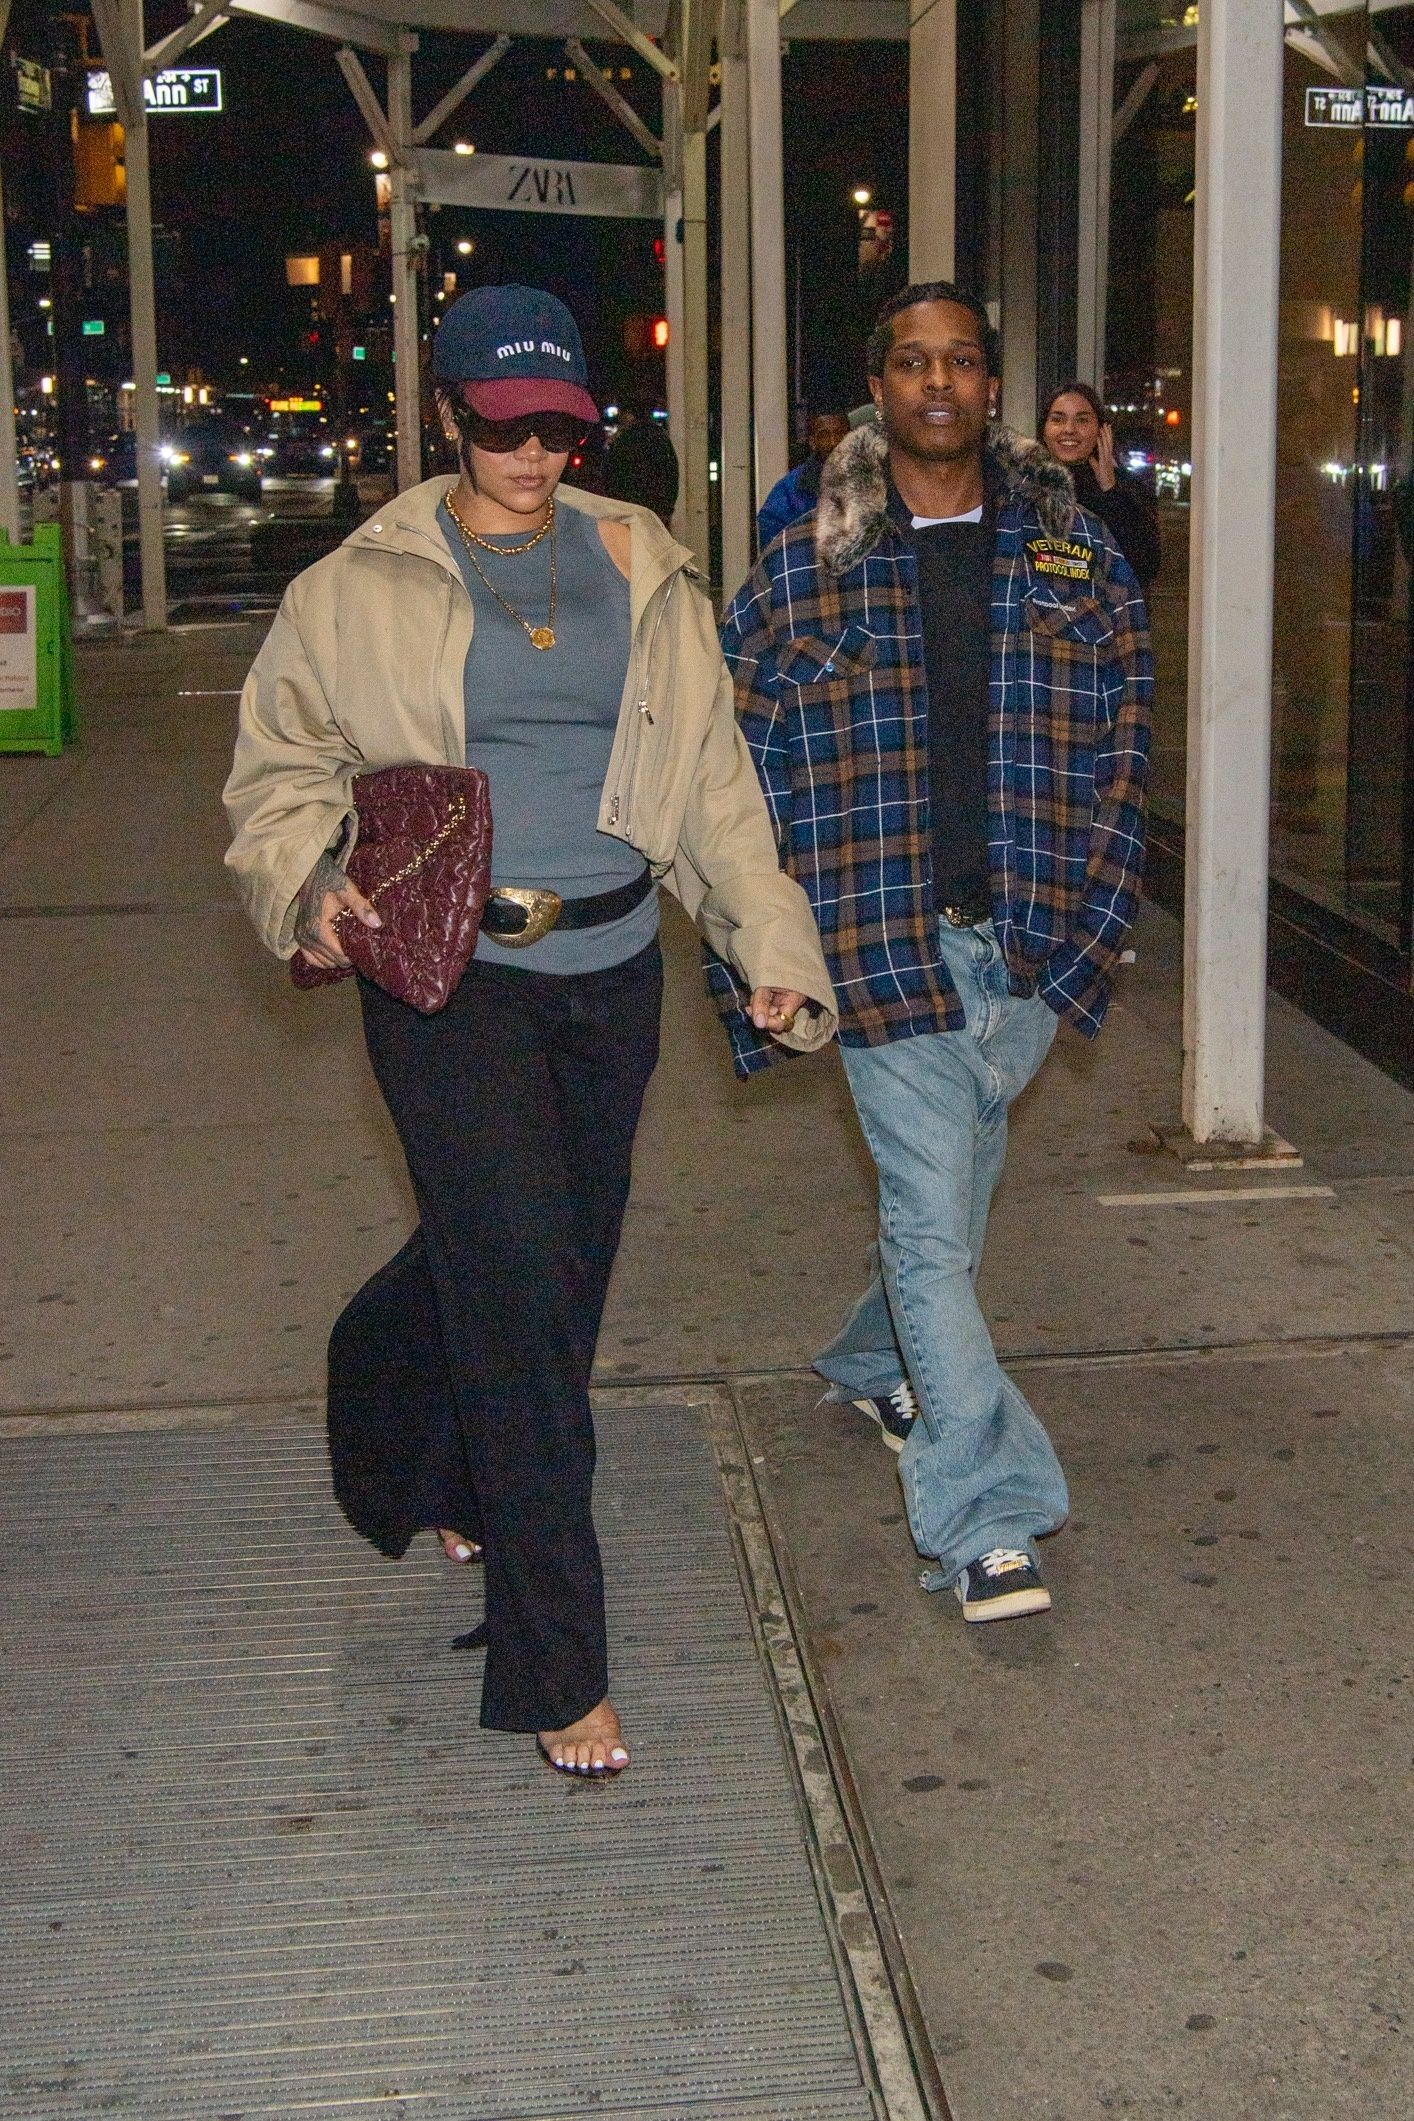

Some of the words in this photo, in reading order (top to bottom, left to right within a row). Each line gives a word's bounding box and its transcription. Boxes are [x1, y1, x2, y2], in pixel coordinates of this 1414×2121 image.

[143, 79, 187, 105] Ann
[193, 78, 209, 94] ST
[508, 166, 576, 205] ZARA
[1026, 539, 1093, 561] VETERAN
[1035, 561, 1069, 577] PROTOCOL
[1070, 568, 1090, 580] INDEX
